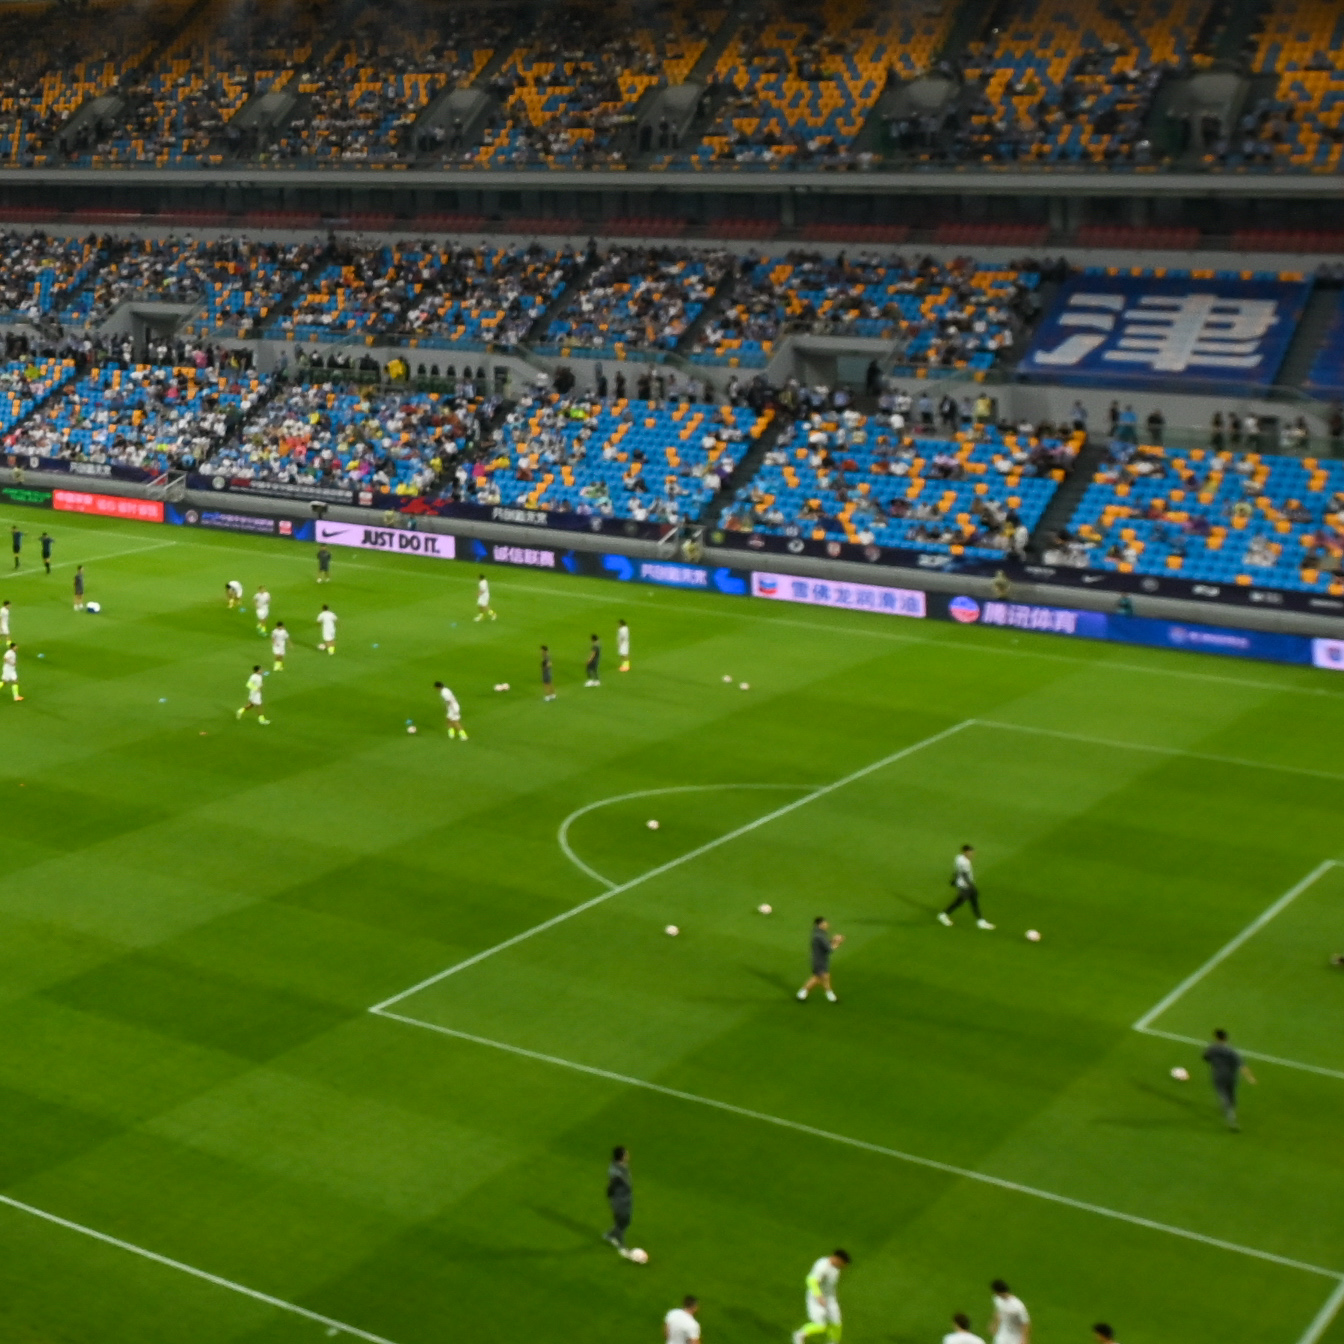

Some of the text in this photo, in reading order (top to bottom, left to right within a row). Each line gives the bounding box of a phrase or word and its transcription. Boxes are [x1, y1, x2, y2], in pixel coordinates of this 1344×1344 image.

[1033, 293, 1280, 372] 津
[361, 529, 440, 554] JUST DO IT.
[493, 545, 555, 568] 诚信联赛
[791, 581, 922, 613] 雪佛龙润滑油
[981, 601, 1078, 635] 腾讯体育
